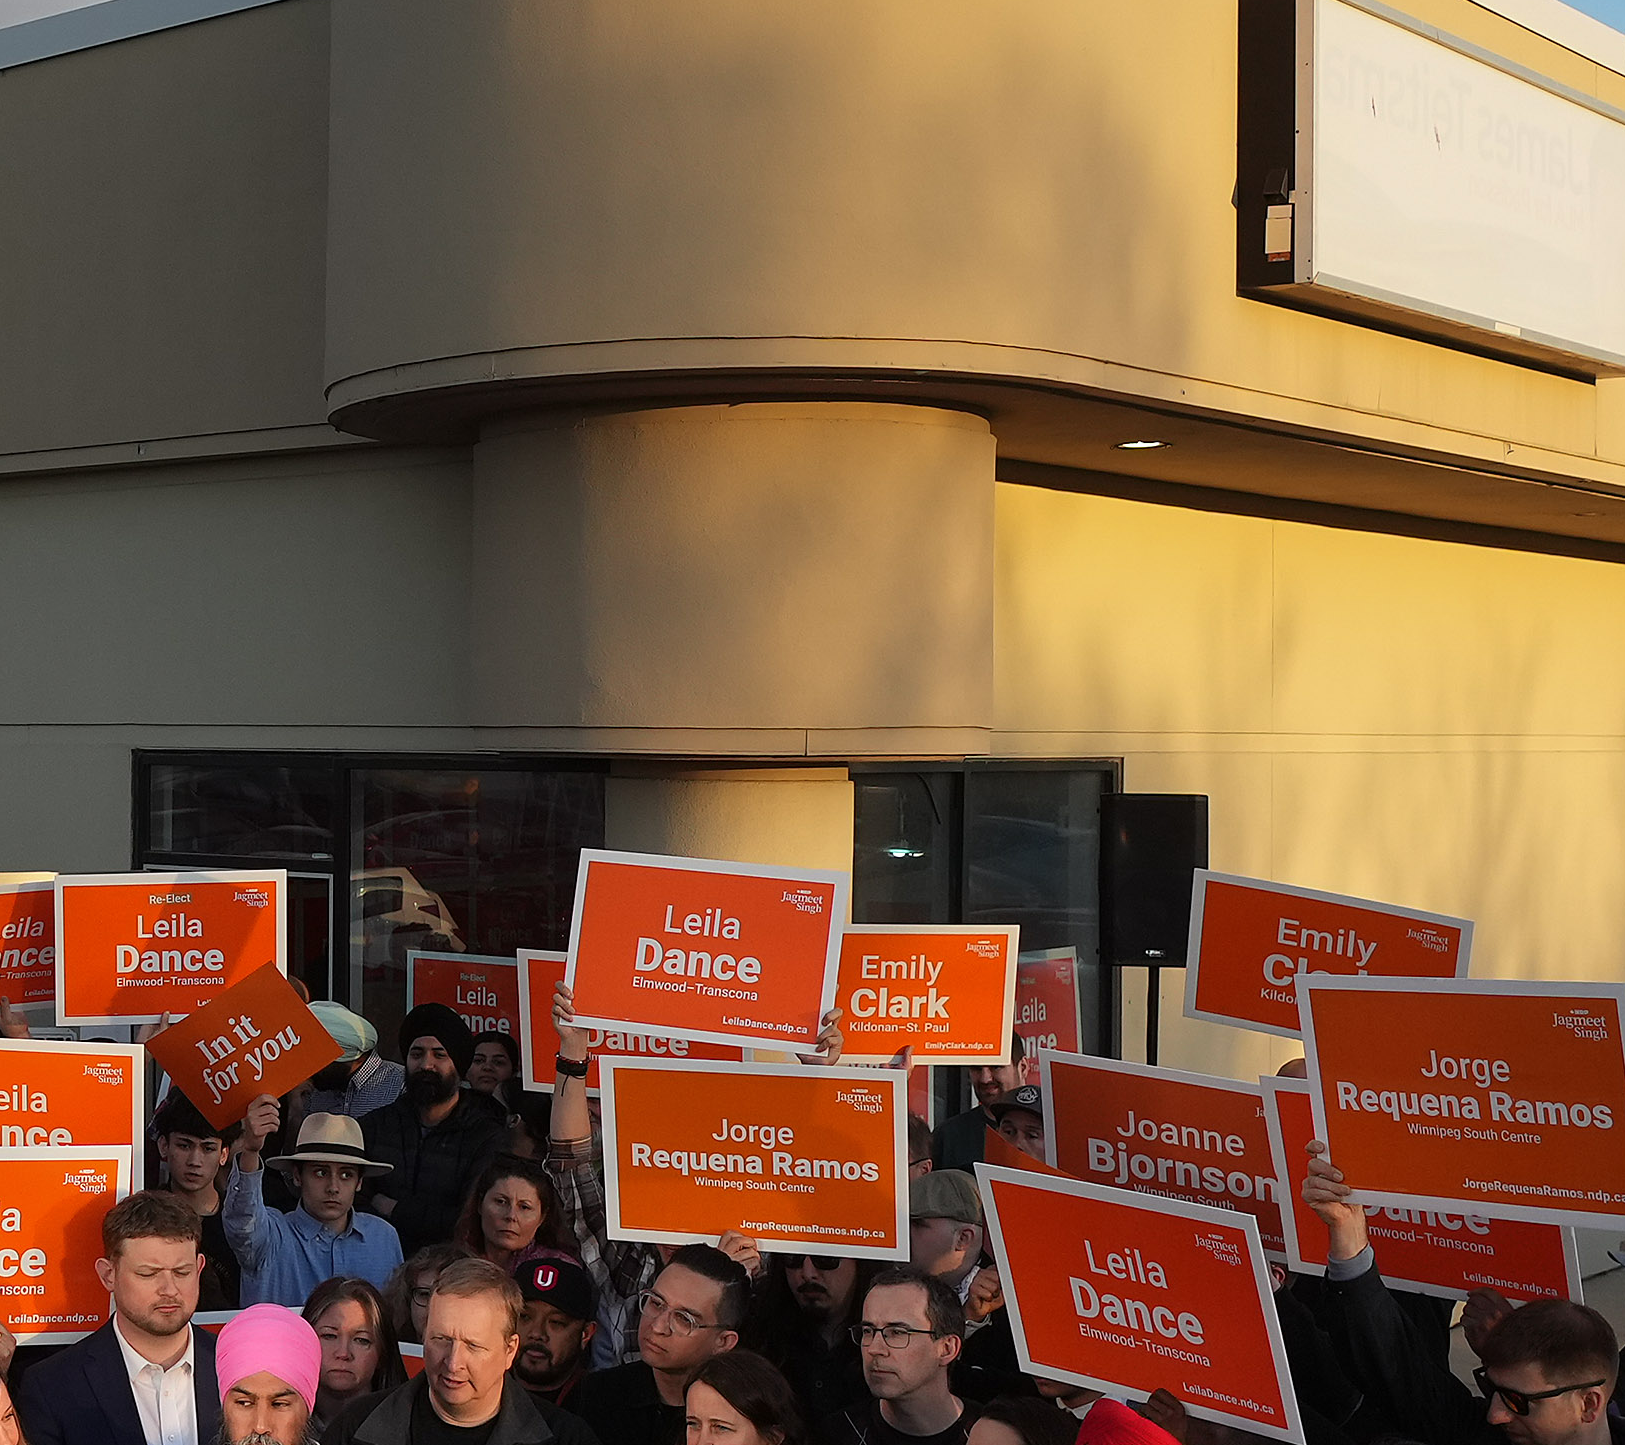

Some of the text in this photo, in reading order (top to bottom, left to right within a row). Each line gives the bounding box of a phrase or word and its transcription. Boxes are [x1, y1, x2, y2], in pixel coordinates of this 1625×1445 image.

[149, 893, 191, 905] Re-Elect
[780, 890, 824, 908] Jagmeet
[796, 901, 823, 915] Singh
[137, 912, 203, 939] Leila
[664, 904, 741, 940] Leila
[1277, 917, 1378, 964] Emily
[116, 944, 225, 974] Dance
[634, 937, 762, 984] Dance
[861, 954, 943, 987] Emily
[456, 985, 497, 1008] Leila
[850, 987, 950, 1019] Clark
[1015, 997, 1047, 1023] Leila
[722, 1015, 808, 1034] LeilaDance.ndp.ca
[924, 1022, 950, 1033] Paul
[1551, 1012, 1607, 1034] Jagmeet
[1572, 1025, 1609, 1042] Singh
[195, 1014, 261, 1066] In it
[924, 1041, 994, 1051] EmilyClark.ndp.ca
[82, 1065, 124, 1079] Jagmeet
[202, 1025, 301, 1104] for you
[1420, 1049, 1511, 1089] Jorge
[98, 1074, 124, 1086] Singh
[835, 1090, 883, 1107] Jagmeet
[853, 1100, 883, 1114] Singh
[1336, 1081, 1614, 1129] Requena Ramos
[711, 1118, 794, 1150] Jorge
[1116, 1110, 1245, 1157] Joanne
[1406, 1122, 1542, 1144] Winnipeg South Centre
[631, 1142, 879, 1184] Requena Ramos
[1087, 1137, 1281, 1205] Bjornson
[62, 1172, 108, 1188] Jagmeet
[79, 1182, 108, 1195] Singh
[694, 1176, 817, 1195] Winnipeg South Centre
[1133, 1184, 1237, 1211] Winnipeg South
[739, 1219, 885, 1239] JorgeRequenaRamos.ndp.ca
[1365, 1225, 1495, 1256] mwood–Transcona
[1193, 1234, 1241, 1255] Jagmeet
[1084, 1239, 1168, 1290] Leila
[1213, 1247, 1243, 1267] Singh
[538, 1269, 554, 1287] U
[1462, 1271, 1558, 1297] LeilaDance.ndp.ca
[8, 1312, 99, 1325] LeilaDance.ndp.ca
[1069, 1276, 1205, 1345] Dance
[1182, 1381, 1275, 1415] LeilaDance.ndp.ca
